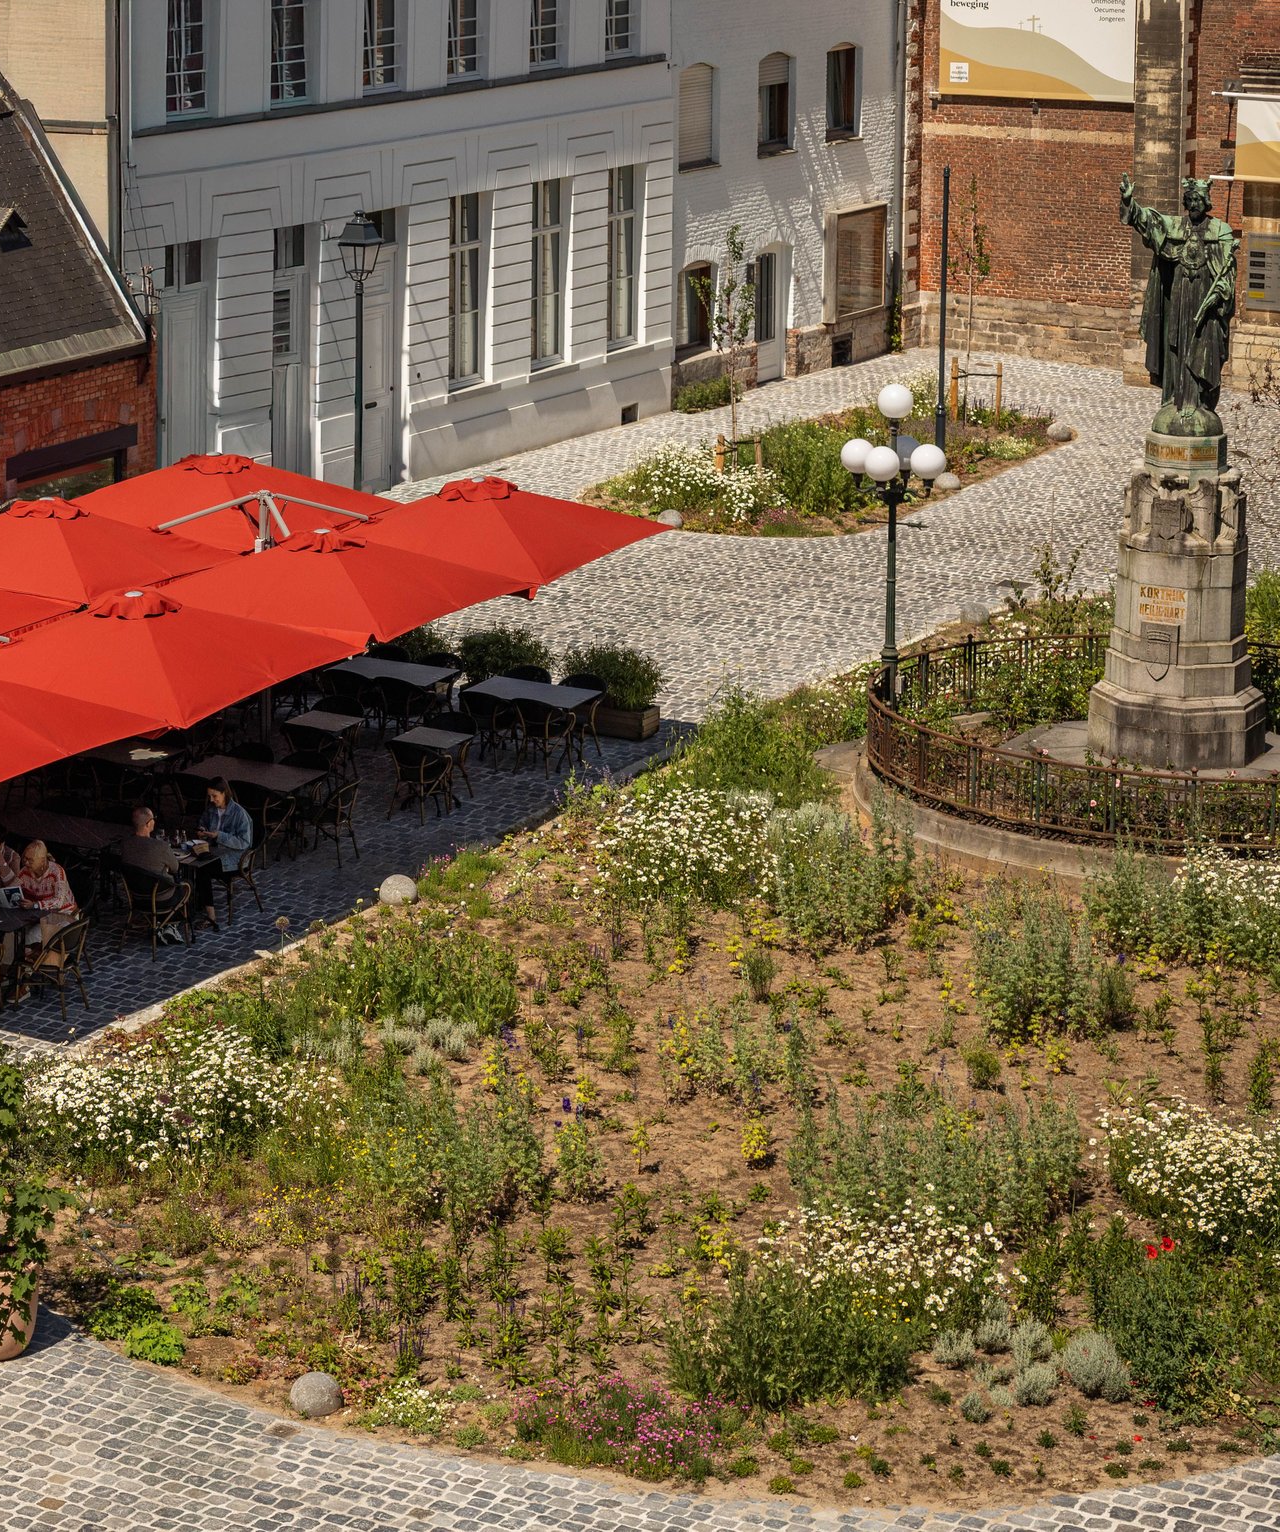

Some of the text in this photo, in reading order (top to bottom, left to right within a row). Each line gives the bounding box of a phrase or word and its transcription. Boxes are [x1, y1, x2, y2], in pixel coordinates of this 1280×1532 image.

[950, 0, 989, 10] beweging
[1094, 6, 1126, 14] Oecumene
[1098, 15, 1126, 23] Jongeren
